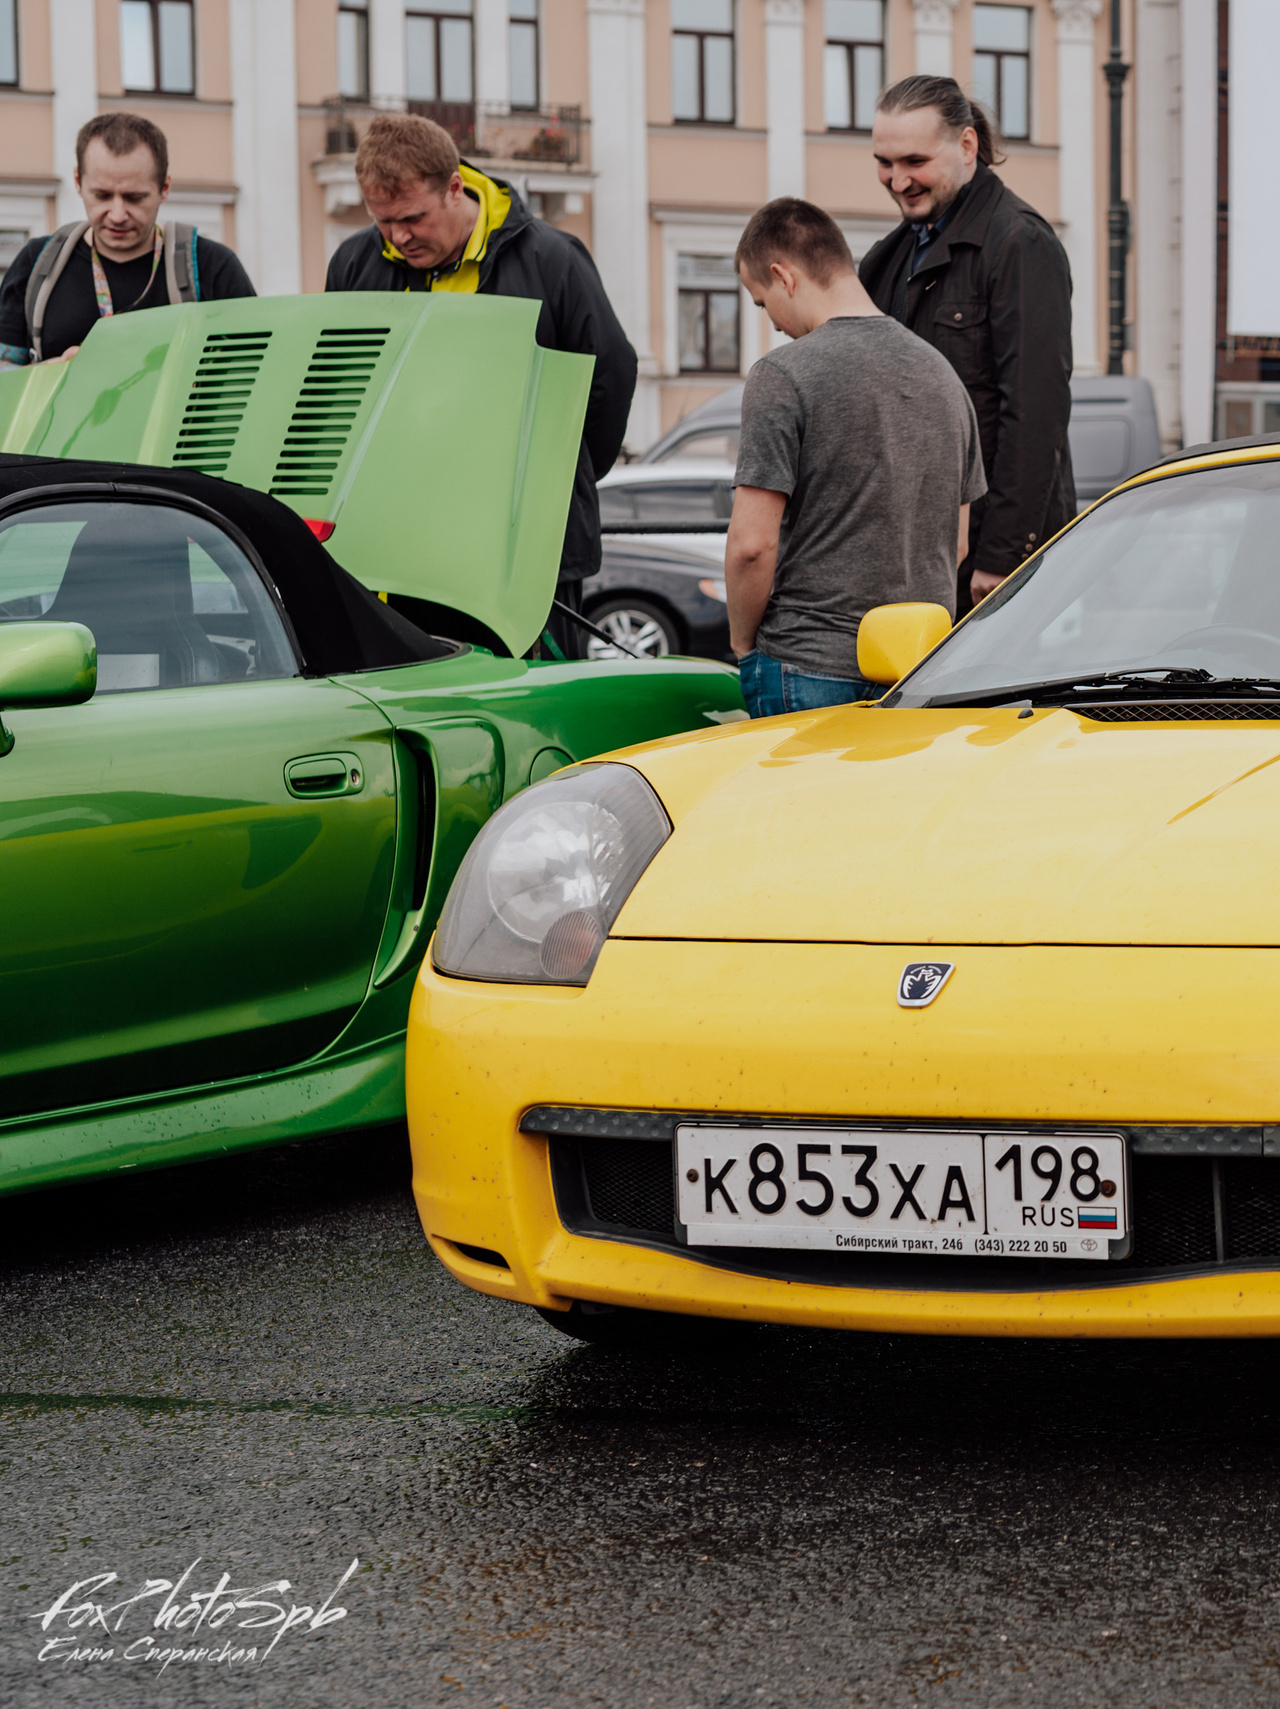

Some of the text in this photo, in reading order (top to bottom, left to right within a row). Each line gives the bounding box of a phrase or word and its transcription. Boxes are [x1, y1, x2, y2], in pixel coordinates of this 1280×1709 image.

[995, 1143, 1102, 1202] 198
[1021, 1206, 1075, 1227] RUS
[835, 1234, 898, 1249] Сибирский
[902, 1239, 938, 1251] тракт,
[974, 1239, 1004, 1254] (343)
[1008, 1240, 1030, 1252] 222
[1034, 1240, 1048, 1253] 20
[1052, 1241, 1067, 1253] 50
